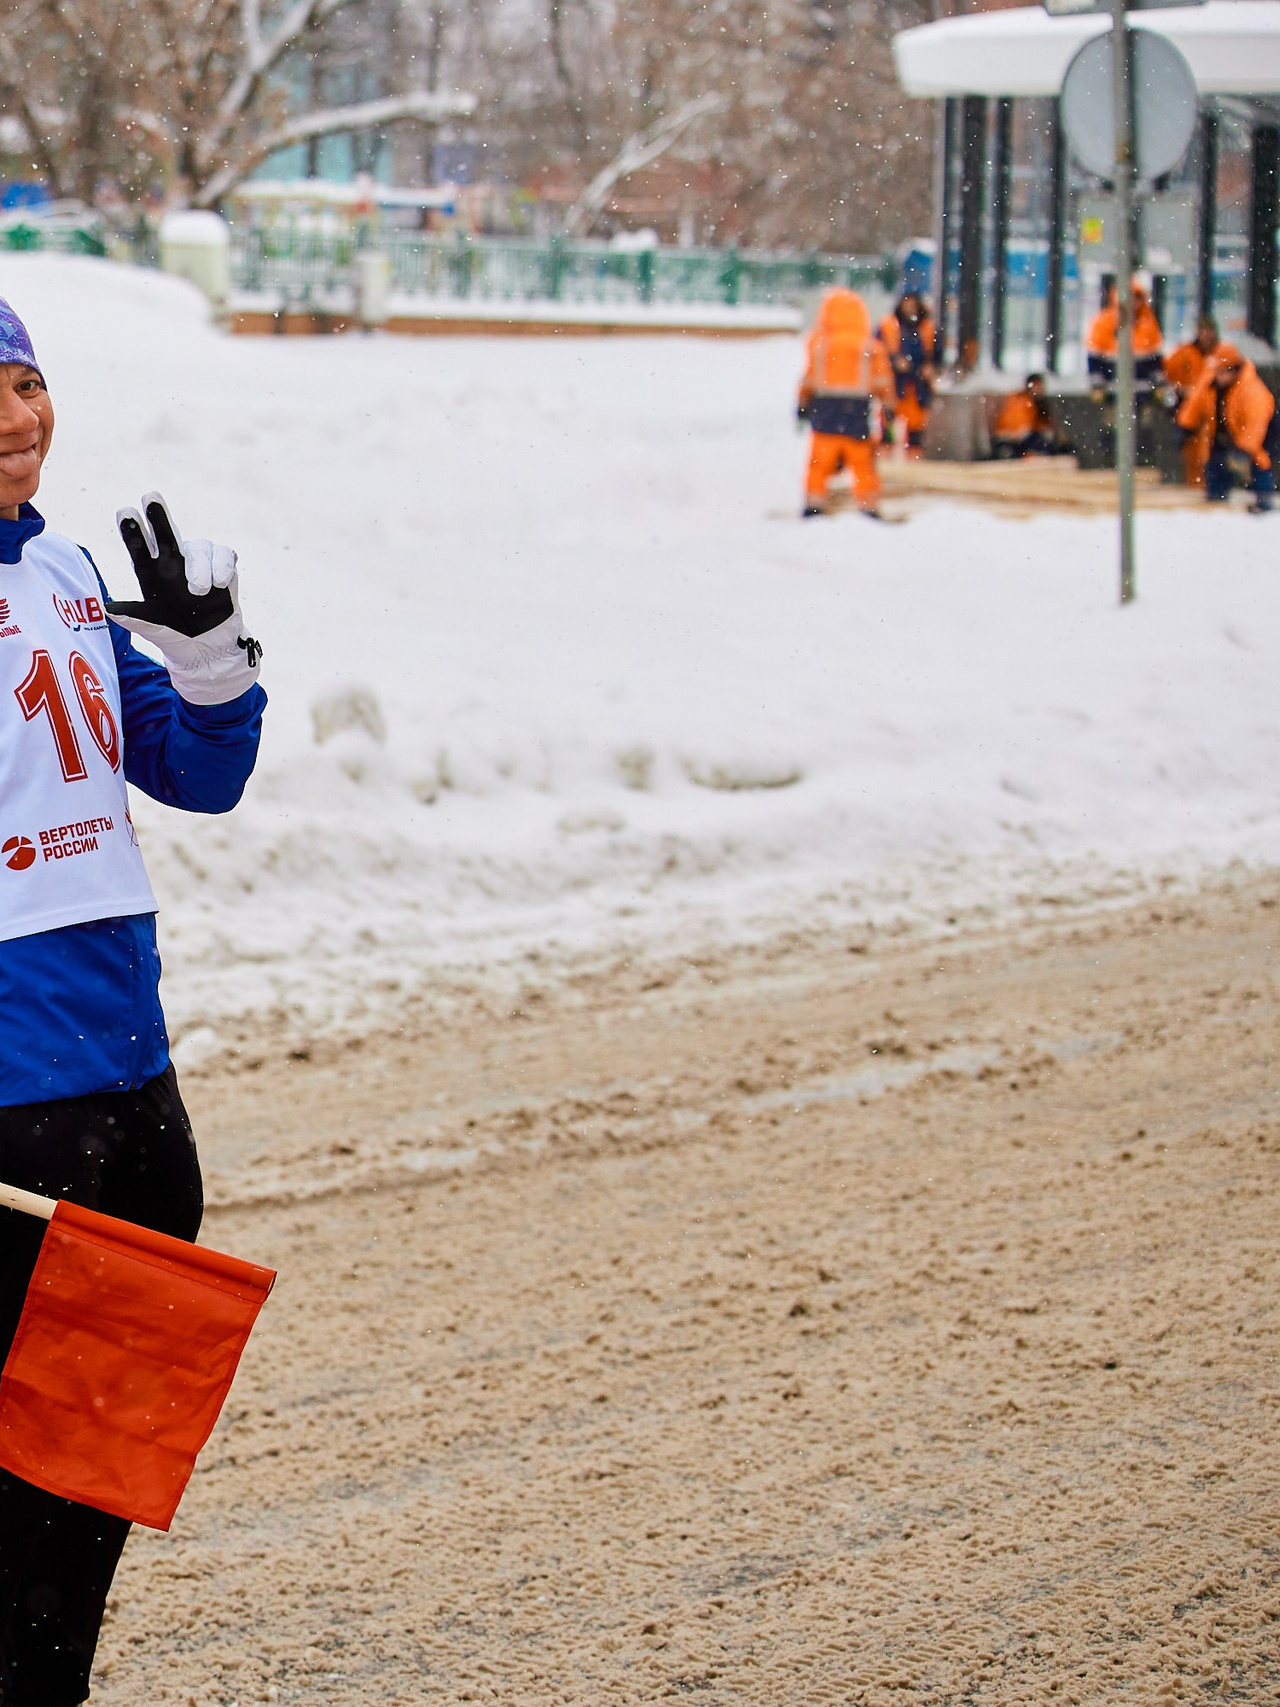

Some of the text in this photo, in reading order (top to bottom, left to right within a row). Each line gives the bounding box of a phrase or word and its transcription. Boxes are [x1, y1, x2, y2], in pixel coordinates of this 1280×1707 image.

[14, 649, 121, 783] 16
[38, 816, 114, 846] ВЕРТОЛЕТЫ
[42, 836, 99, 862] РОССИИ
